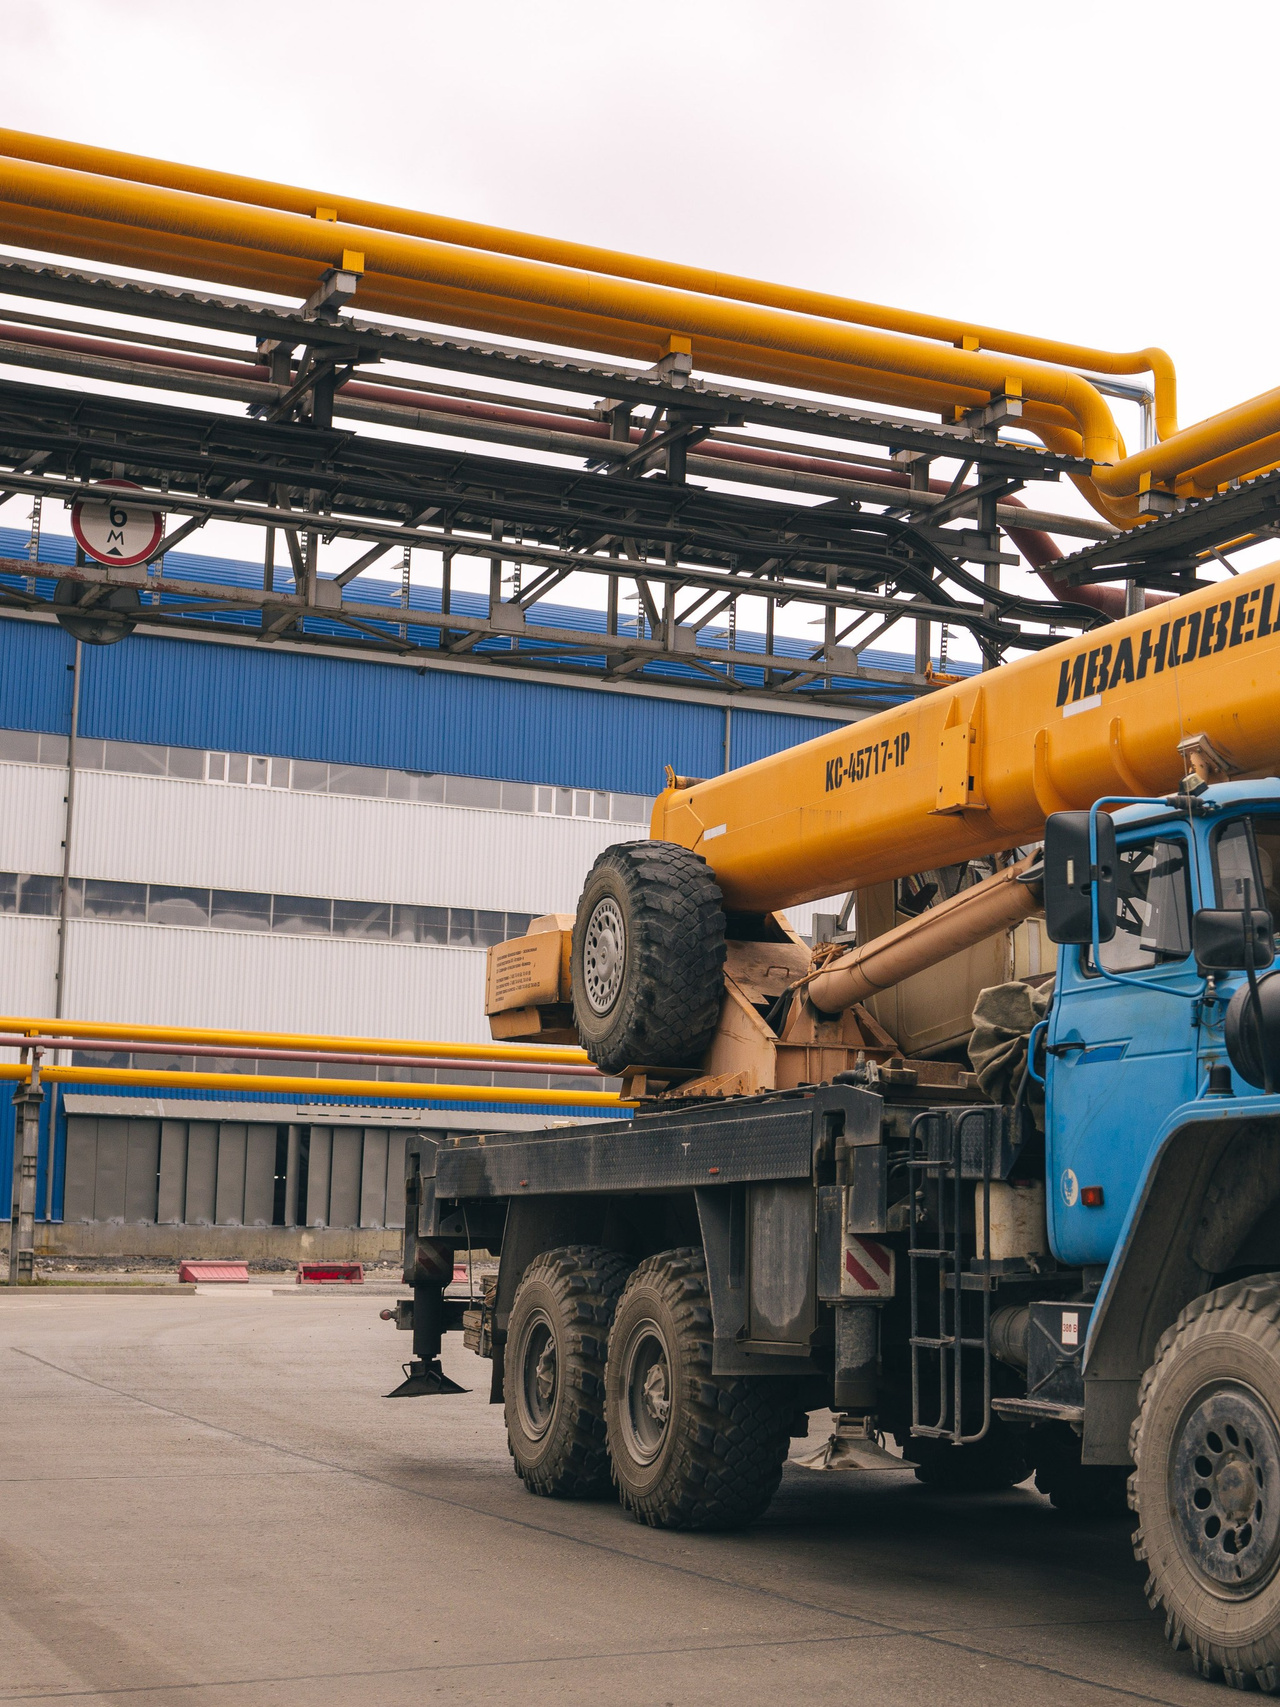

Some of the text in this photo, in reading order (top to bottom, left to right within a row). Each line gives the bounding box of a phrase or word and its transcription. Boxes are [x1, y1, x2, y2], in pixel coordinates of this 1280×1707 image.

[109, 506, 128, 528] 6
[107, 530, 124, 545] М
[825, 731, 910, 793] КС-45717-1Р
